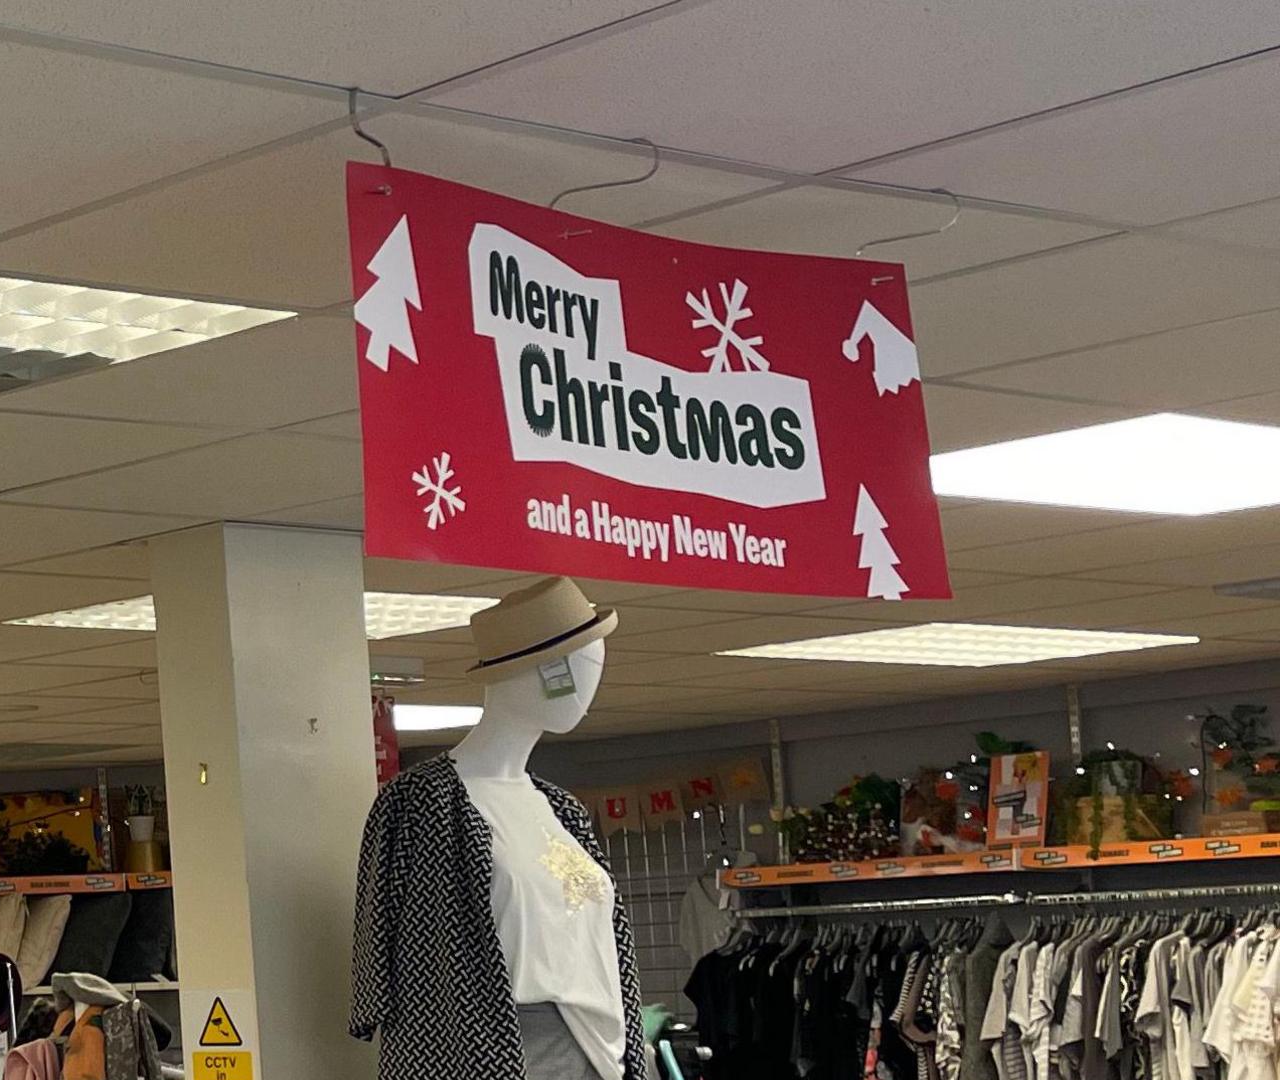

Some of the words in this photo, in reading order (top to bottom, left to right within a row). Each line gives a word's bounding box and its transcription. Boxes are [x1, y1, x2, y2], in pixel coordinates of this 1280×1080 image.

[489, 249, 599, 360] Merry
[519, 343, 806, 471] Christmas
[527, 494, 571, 536] and
[576, 509, 589, 540] a
[591, 501, 670, 562] Happy
[675, 515, 727, 560] New
[729, 521, 787, 568] Year
[205, 1056, 236, 1068] CCTV
[216, 1070, 227, 1080] in
